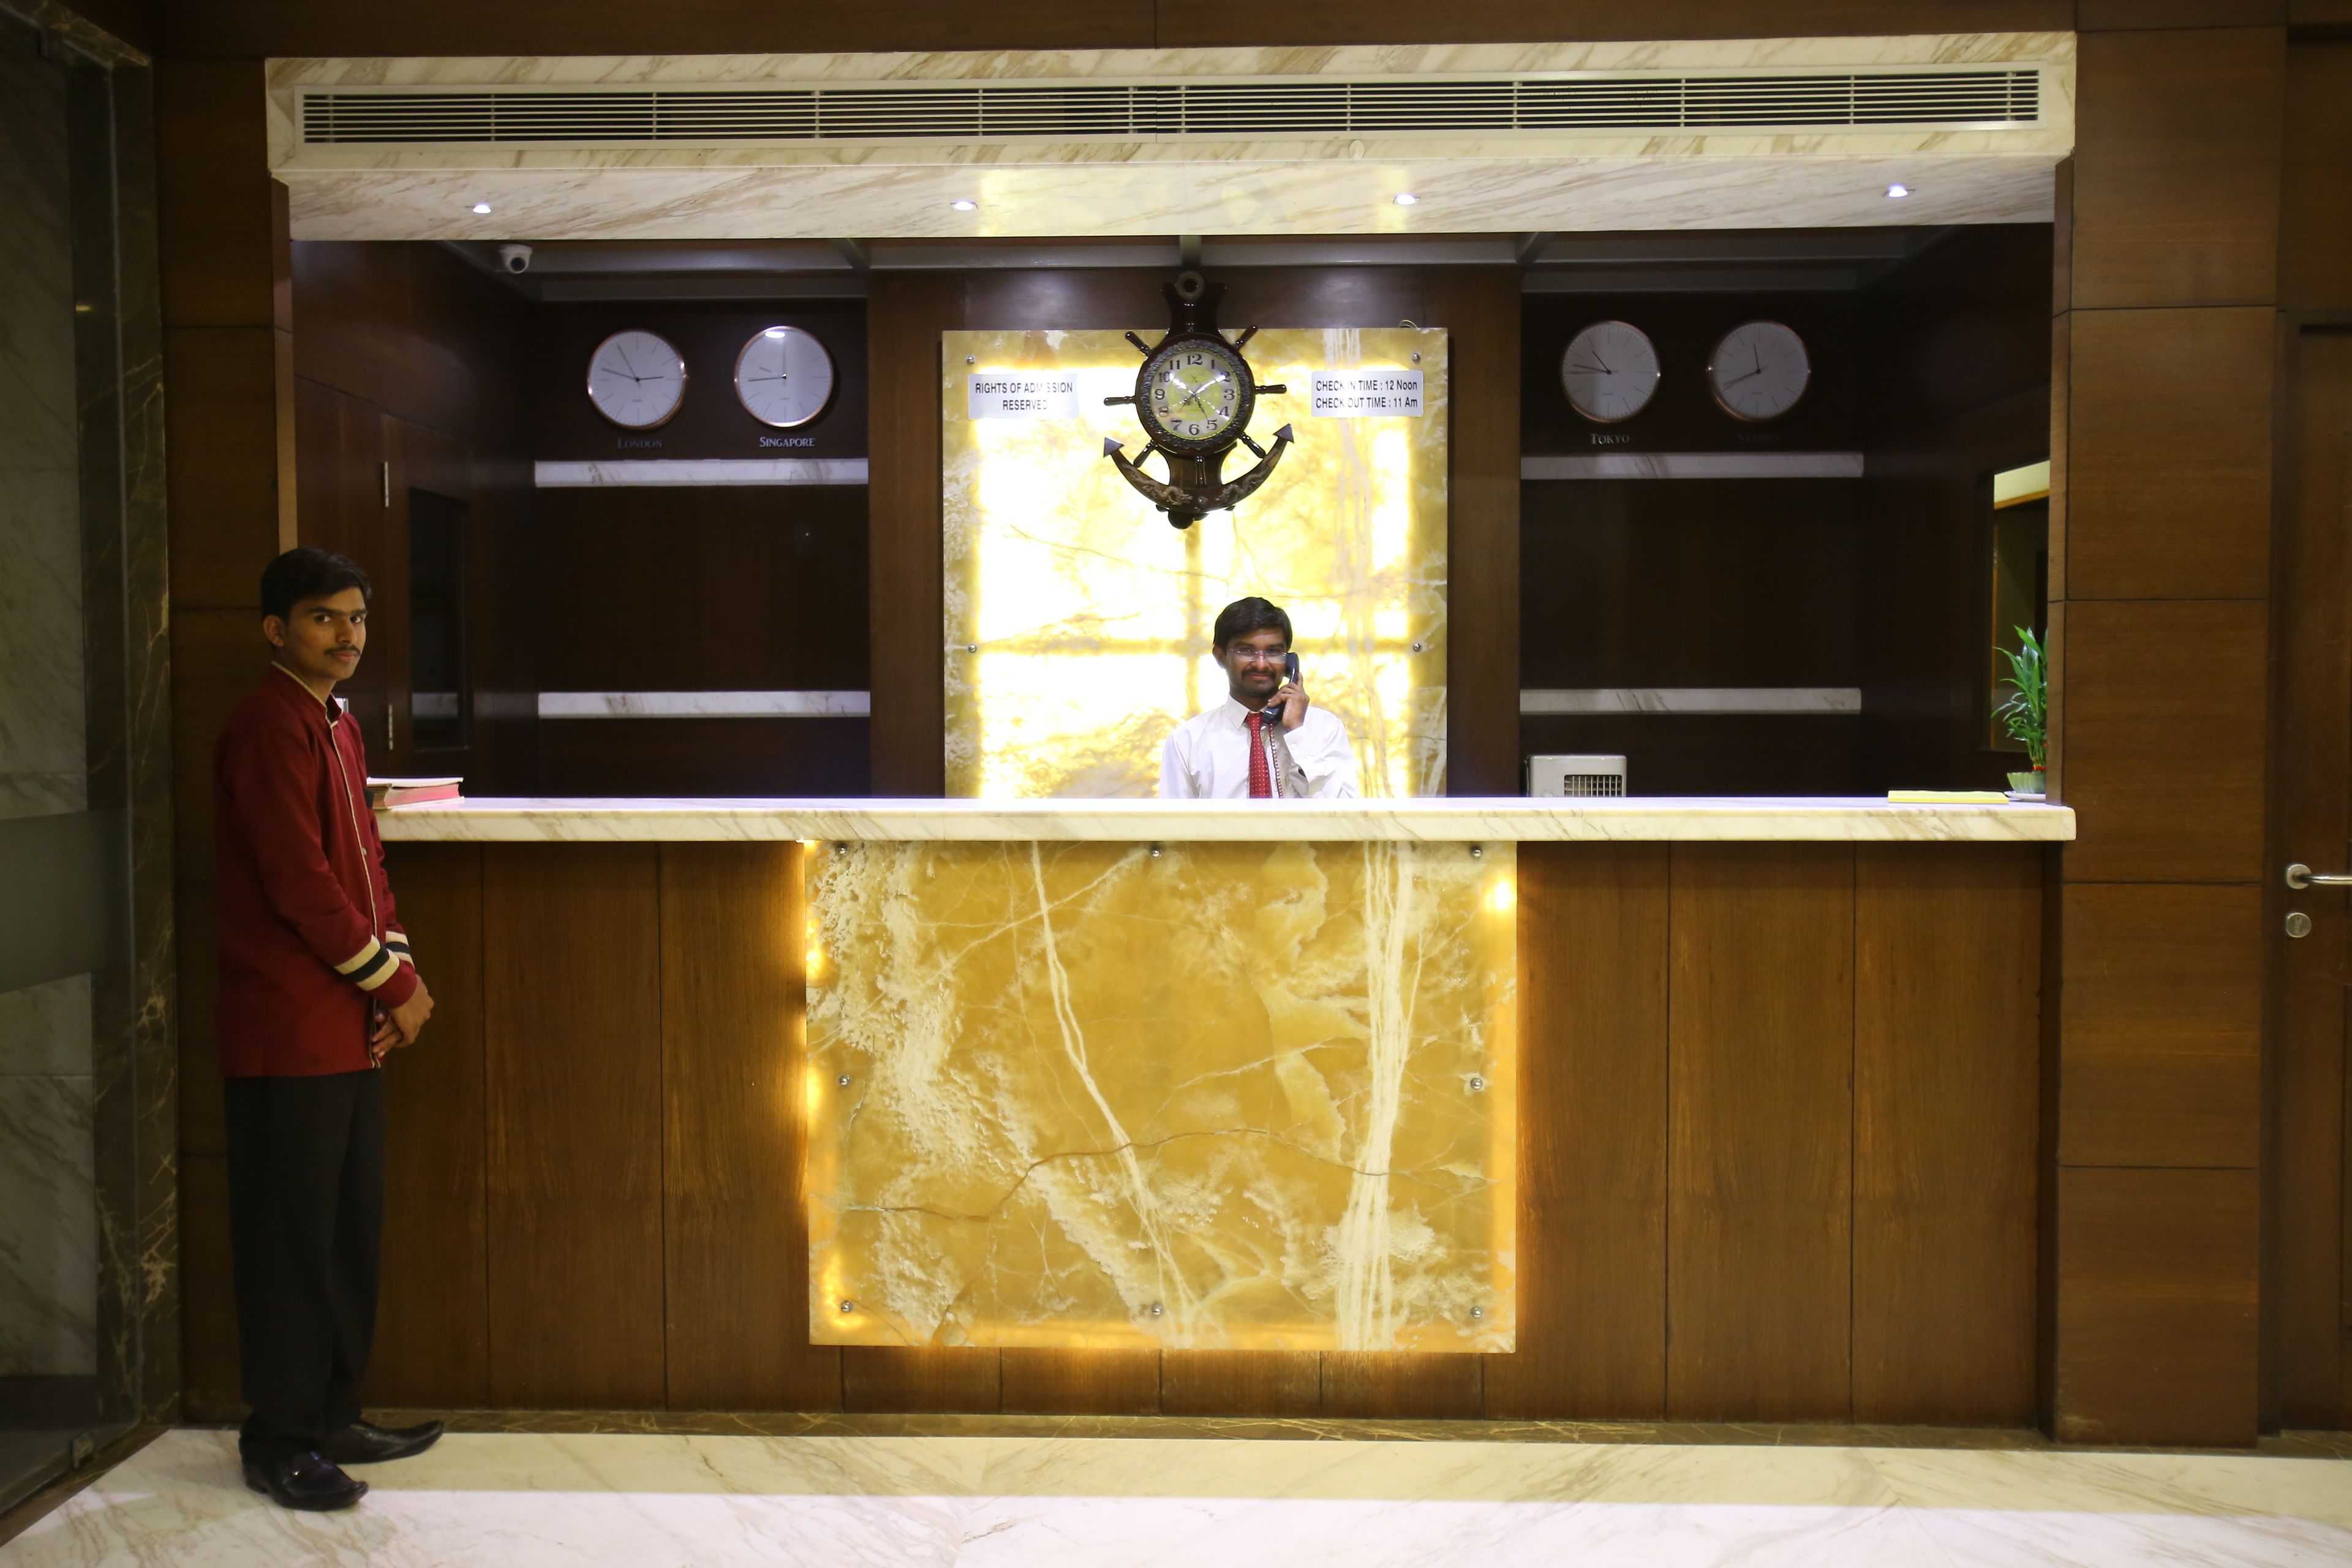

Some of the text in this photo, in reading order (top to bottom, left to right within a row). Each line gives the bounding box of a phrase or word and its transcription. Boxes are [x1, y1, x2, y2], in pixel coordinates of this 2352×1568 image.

[1169, 360, 1180, 370] 11
[1187, 354, 1203, 366] 12
[1211, 360, 1216, 369] 1
[1159, 372, 1170, 383] 10
[1221, 371, 1231, 382] 2
[975, 382, 1073, 394] RIGHTS OF ADMSSION
[1316, 380, 1345, 391] CHECK
[1348, 380, 1356, 391] IN
[1359, 380, 1378, 391] TIME
[1385, 380, 1394, 390] 12
[1397, 380, 1417, 390] Noon
[1155, 389, 1165, 400] 9
[1224, 389, 1235, 401] 3
[1003, 399, 1048, 410] RESERVED
[1316, 398, 1345, 409] CHECK
[1348, 398, 1365, 408] OUT
[1366, 397, 1386, 408] TIME
[1393, 397, 1402, 407] 11
[1404, 397, 1418, 407] Am
[1159, 406, 1169, 417] 8
[1219, 406, 1230, 417] 4
[1171, 419, 1182, 431] 7
[1189, 423, 1200, 435] 6
[1207, 419, 1218, 431] 5
[617, 437, 663, 449] LONDON
[760, 436, 815, 448] SINGAPORE
[1590, 433, 1630, 445] TOKYO
